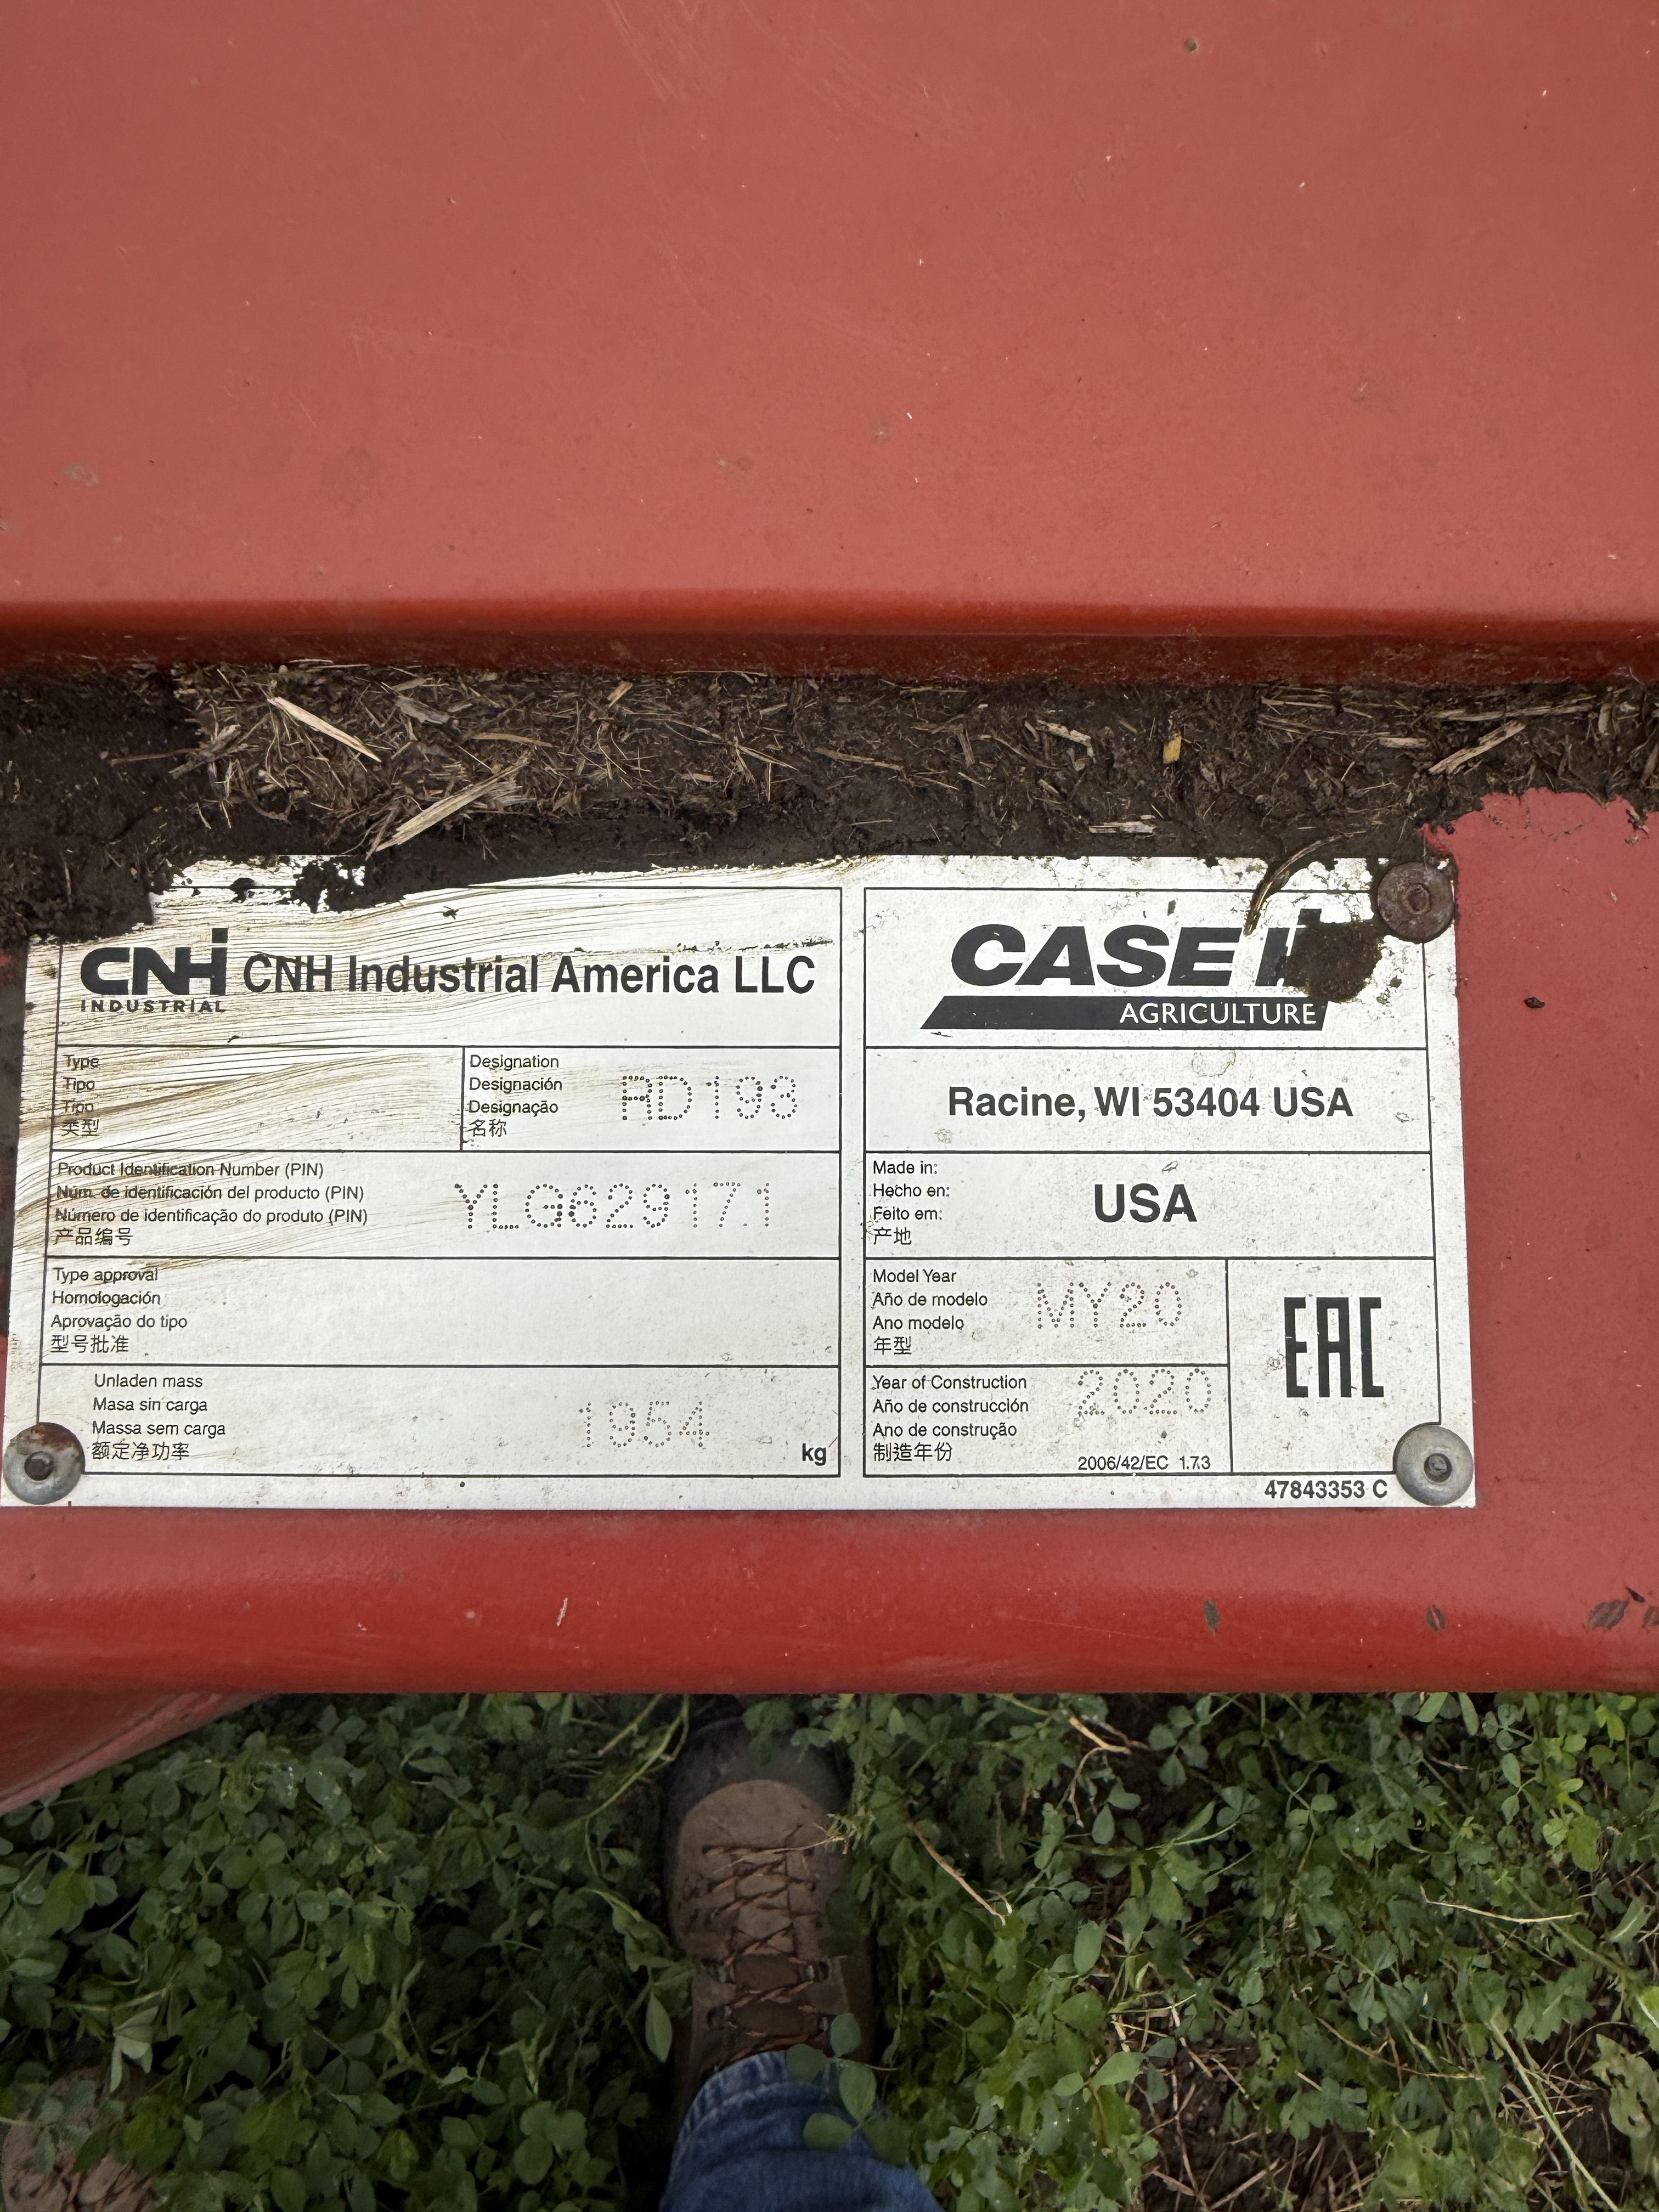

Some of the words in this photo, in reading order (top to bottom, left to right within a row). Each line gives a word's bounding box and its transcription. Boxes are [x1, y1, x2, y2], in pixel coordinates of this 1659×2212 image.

[951, 924, 1244, 986] CASE
[244, 954, 332, 993] CNH
[348, 955, 538, 993] Industrial
[551, 955, 719, 994] America
[735, 955, 816, 994] LLC
[81, 1000, 227, 1013] INDUSTRIAL
[1120, 1001, 1317, 1025] AGRICULTURE
[63, 1054, 99, 1070] Type
[470, 1054, 559, 1072] Designation
[63, 1077, 95, 1092] Tipo
[469, 1077, 562, 1095] Designación
[622, 1076, 798, 1120] RD193
[949, 1086, 1086, 1121] Racine,
[1095, 1087, 1139, 1116] WI
[1153, 1087, 1260, 1118] 53404
[1274, 1087, 1354, 1118] USA
[61, 1100, 94, 1114] Tipo
[469, 1101, 558, 1118] Designação
[61, 1119, 99, 1136] 类型
[469, 1120, 507, 1137] 名称
[58, 1163, 115, 1176] Product
[120, 1163, 214, 1176] Identification
[220, 1163, 280, 1176] Number
[285, 1163, 324, 1180] (PIN)
[873, 1160, 915, 1174] Made
[921, 1160, 938, 1175] in:
[101, 1186, 120, 1200] de
[125, 1186, 222, 1200] identificación
[228, 1186, 250, 1200] del
[255, 1186, 320, 1203] producto
[325, 1186, 364, 1203] (PIN)
[873, 1183, 922, 1197] Hecho
[927, 1186, 950, 1197] en:
[454, 1183, 770, 1229] YLG629171
[1094, 1184, 1197, 1223] USA
[55, 1209, 116, 1223] Número
[121, 1209, 139, 1223] de
[144, 1209, 238, 1226] identificação
[242, 1209, 262, 1223] do
[267, 1209, 323, 1226] produto
[329, 1209, 368, 1226] (PIN)
[873, 1206, 910, 1220] Feito
[915, 1209, 943, 1221] em:
[54, 1228, 133, 1246] 产品编号
[873, 1227, 912, 1245] 产地
[53, 1267, 88, 1284] Type
[94, 1267, 158, 1284] approval
[873, 1269, 919, 1282] Model
[923, 1269, 957, 1283] Year
[52, 1290, 161, 1307] Homologación
[873, 1291, 904, 1306] Año
[909, 1292, 927, 1306] de
[932, 1292, 988, 1306] modelo
[1037, 1282, 1182, 1328] MY20
[50, 1314, 131, 1331] Aprovação
[137, 1314, 155, 1328] do
[161, 1314, 187, 1331] tipo
[873, 1316, 904, 1330] Ano
[909, 1316, 964, 1330] modelo
[50, 1334, 129, 1353] 型号批准
[873, 1336, 912, 1355] 年型
[1284, 1297, 1385, 1398] EAC
[94, 1374, 157, 1387] Unladen
[163, 1377, 203, 1387] mass
[872, 1375, 907, 1389] Year
[912, 1375, 927, 1389] of
[931, 1375, 1027, 1390] Construction
[1077, 1369, 1211, 1415] 2020
[93, 1397, 134, 1410] Masa
[139, 1397, 160, 1410] sin
[166, 1401, 207, 1414] carga
[872, 1399, 903, 1413] Año
[909, 1399, 927, 1413] de
[932, 1398, 1029, 1413] construcción
[92, 1421, 142, 1435] Massa
[147, 1425, 179, 1435] sem
[184, 1425, 225, 1438] carga
[579, 1402, 709, 1448] 1954
[872, 1423, 903, 1436] Ano
[909, 1423, 927, 1436] de
[932, 1422, 1017, 1440] construção
[92, 1440, 190, 1460] 额定净功率
[802, 1443, 827, 1465] kg
[873, 1441, 952, 1462] 制造年份
[1078, 1455, 1169, 1470] 2006/42/EC
[1265, 1481, 1365, 1499] 47843353
[1372, 1481, 1387, 1498] C
